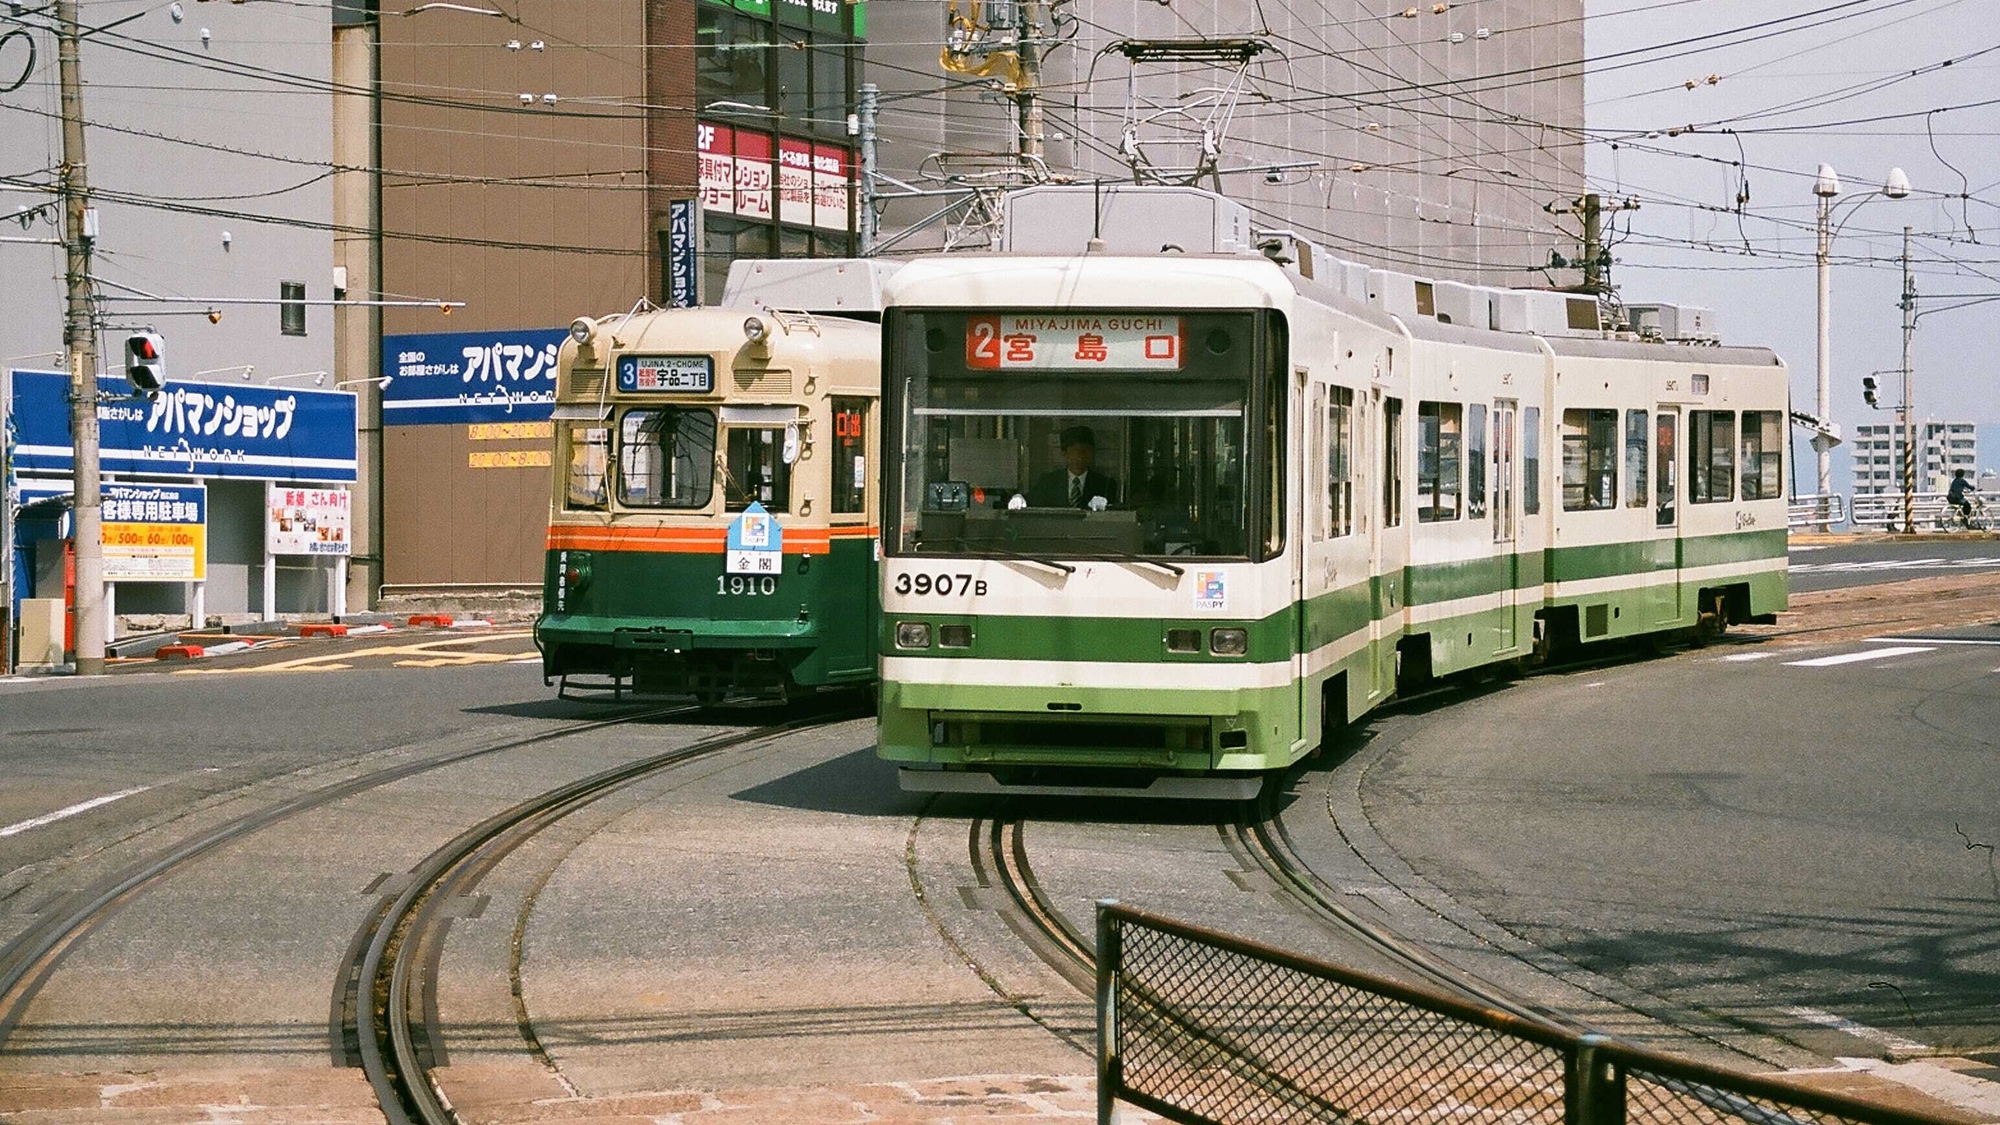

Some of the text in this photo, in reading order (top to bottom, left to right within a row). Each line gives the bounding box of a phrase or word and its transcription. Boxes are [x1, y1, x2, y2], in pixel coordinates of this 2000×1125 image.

[698, 124, 714, 150] 2F
[1015, 319, 1163, 331] MIYAJIMA GUCHI
[974, 322, 995, 359] 2
[1004, 332, 1175, 362] 宮島口
[623, 362, 635, 385] 3
[641, 360, 704, 368] UJINA 2-CHOME
[657, 368, 707, 387] 宇品二丁目
[147, 387, 296, 440] アパマンショップ
[101, 499, 198, 522] 客様専用駐車場
[717, 575, 775, 596] 1910
[1196, 600, 1224, 609] PASPY
